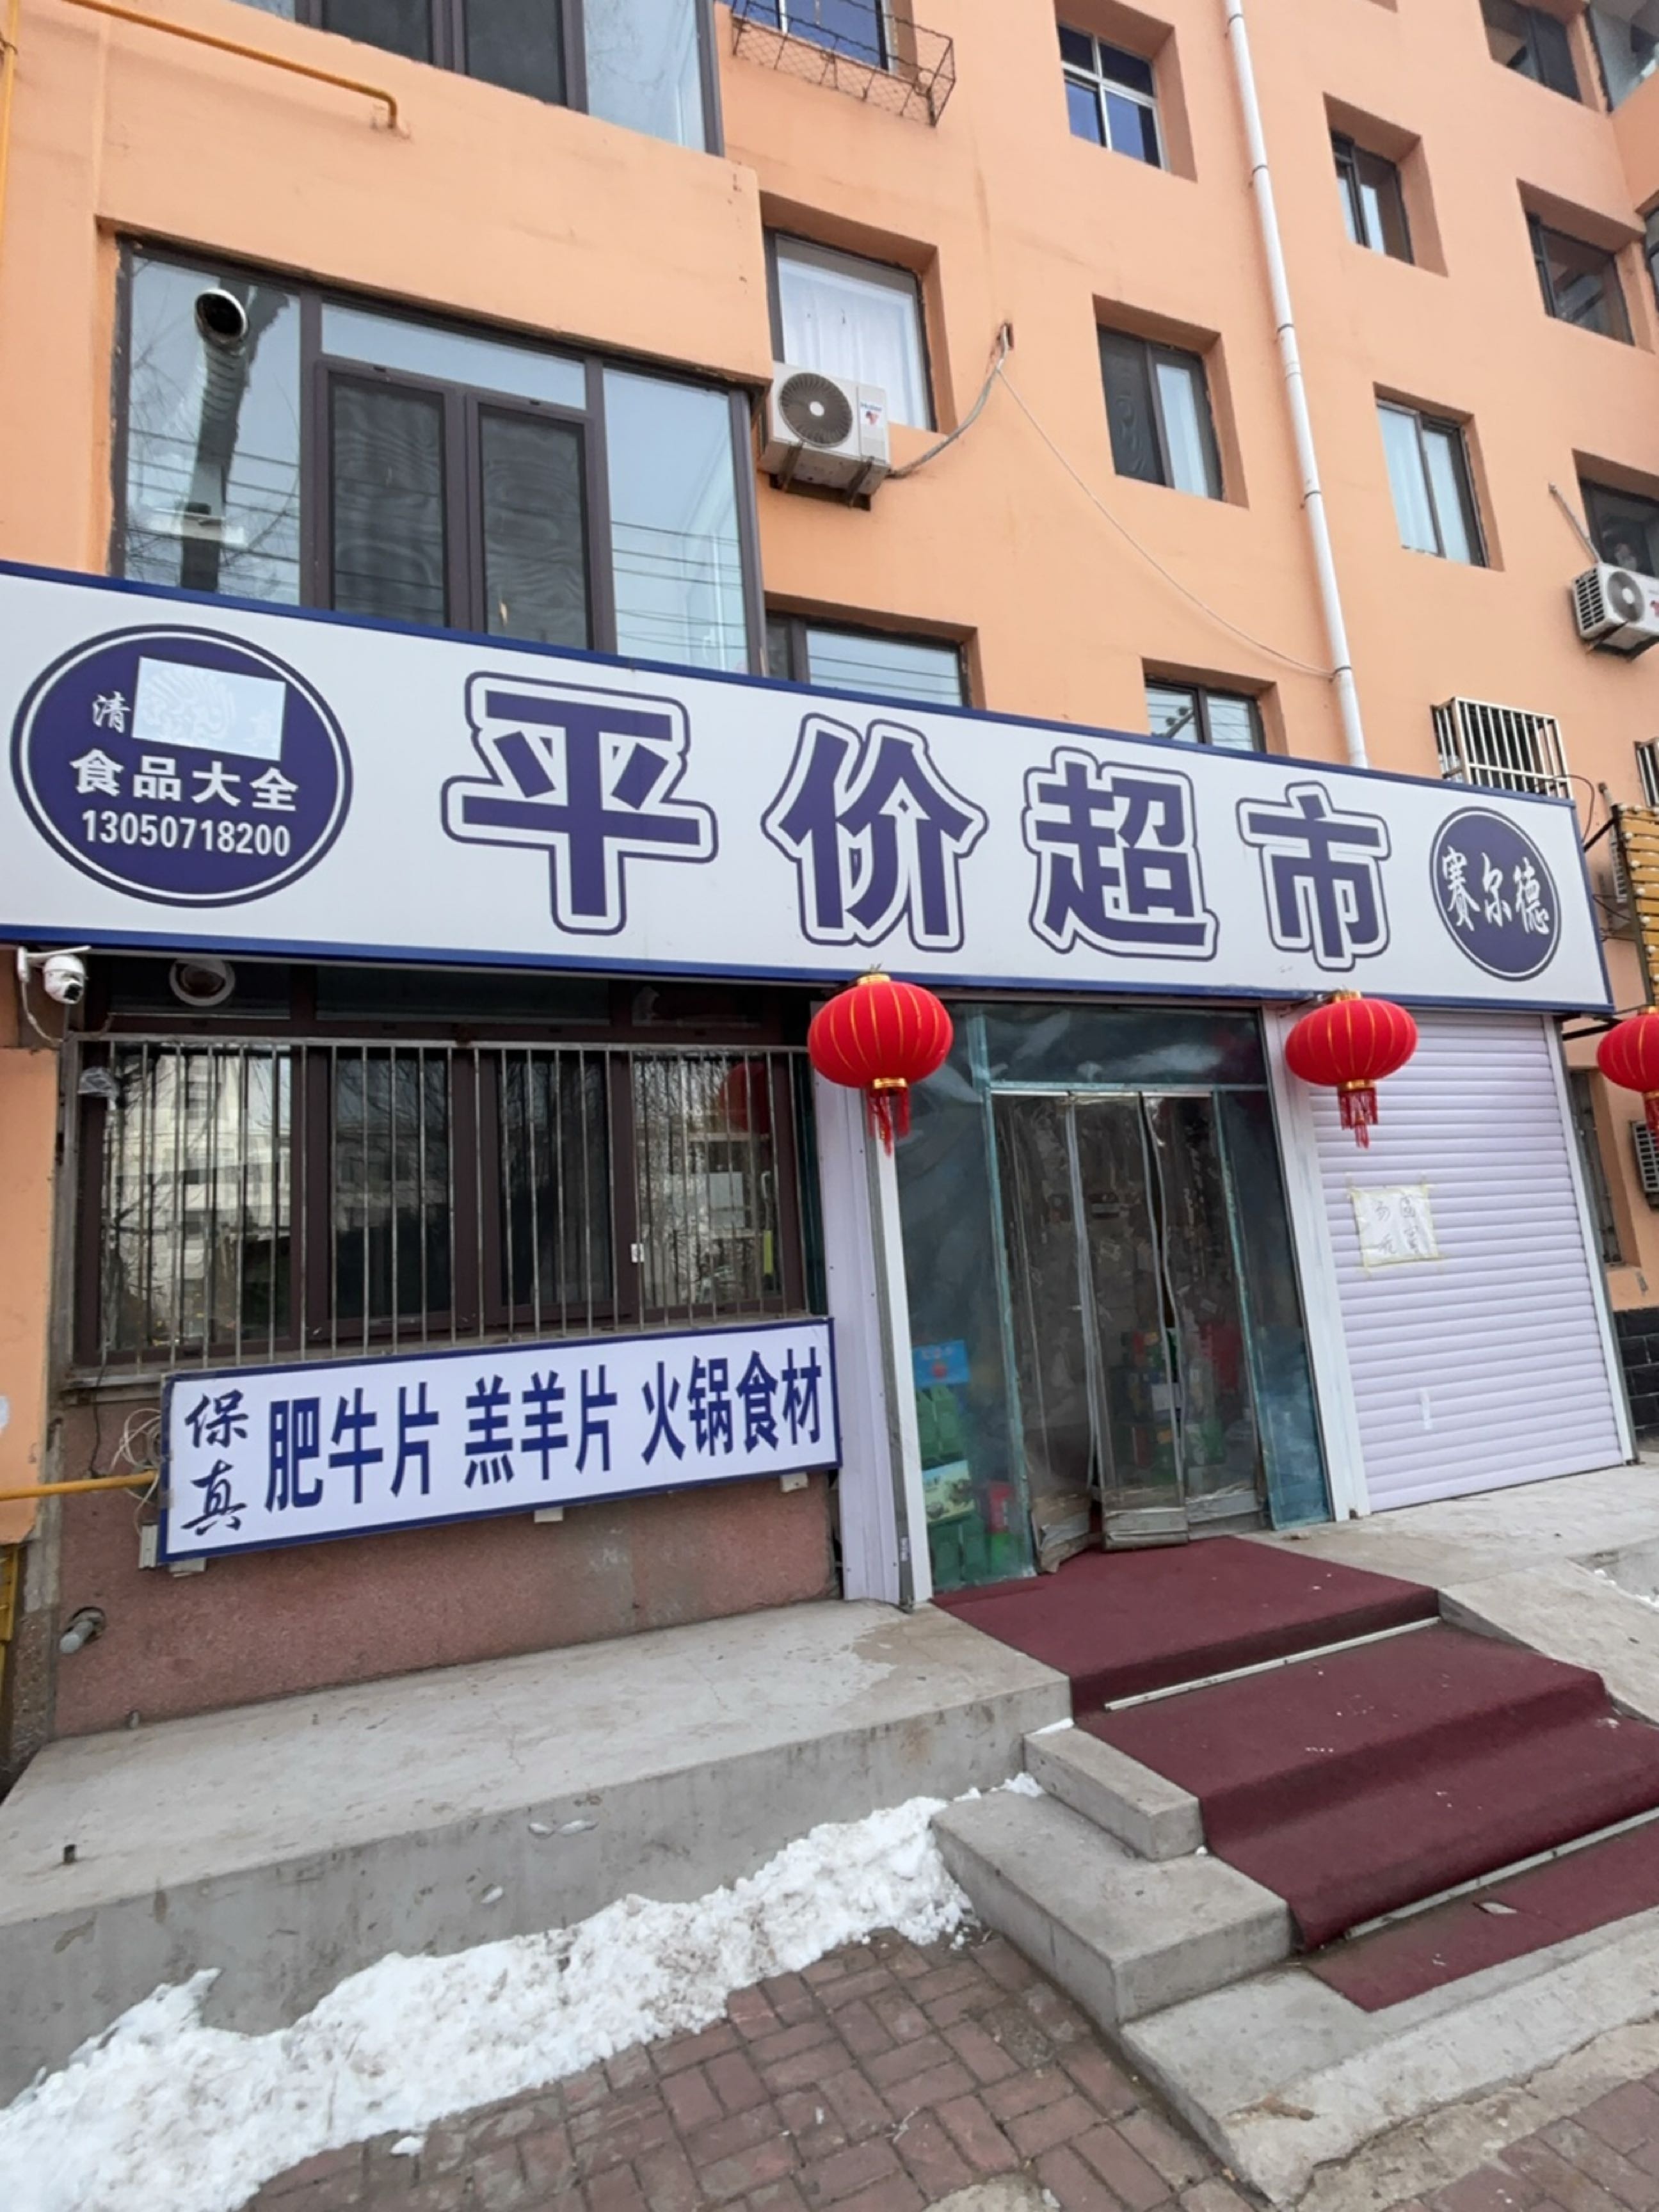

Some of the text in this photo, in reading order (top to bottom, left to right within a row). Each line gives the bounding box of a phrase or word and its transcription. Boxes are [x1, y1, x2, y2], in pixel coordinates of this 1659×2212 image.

[70, 748, 299, 812] 食品大全
[82, 810, 291, 857] 13050718200
[442, 671, 1391, 972] 平价超市
[1441, 845, 1550, 935] 赛尔德
[182, 1389, 250, 1536] 保真
[265, 1346, 824, 1514] 肥牛片 羔羊片 火锅食材
